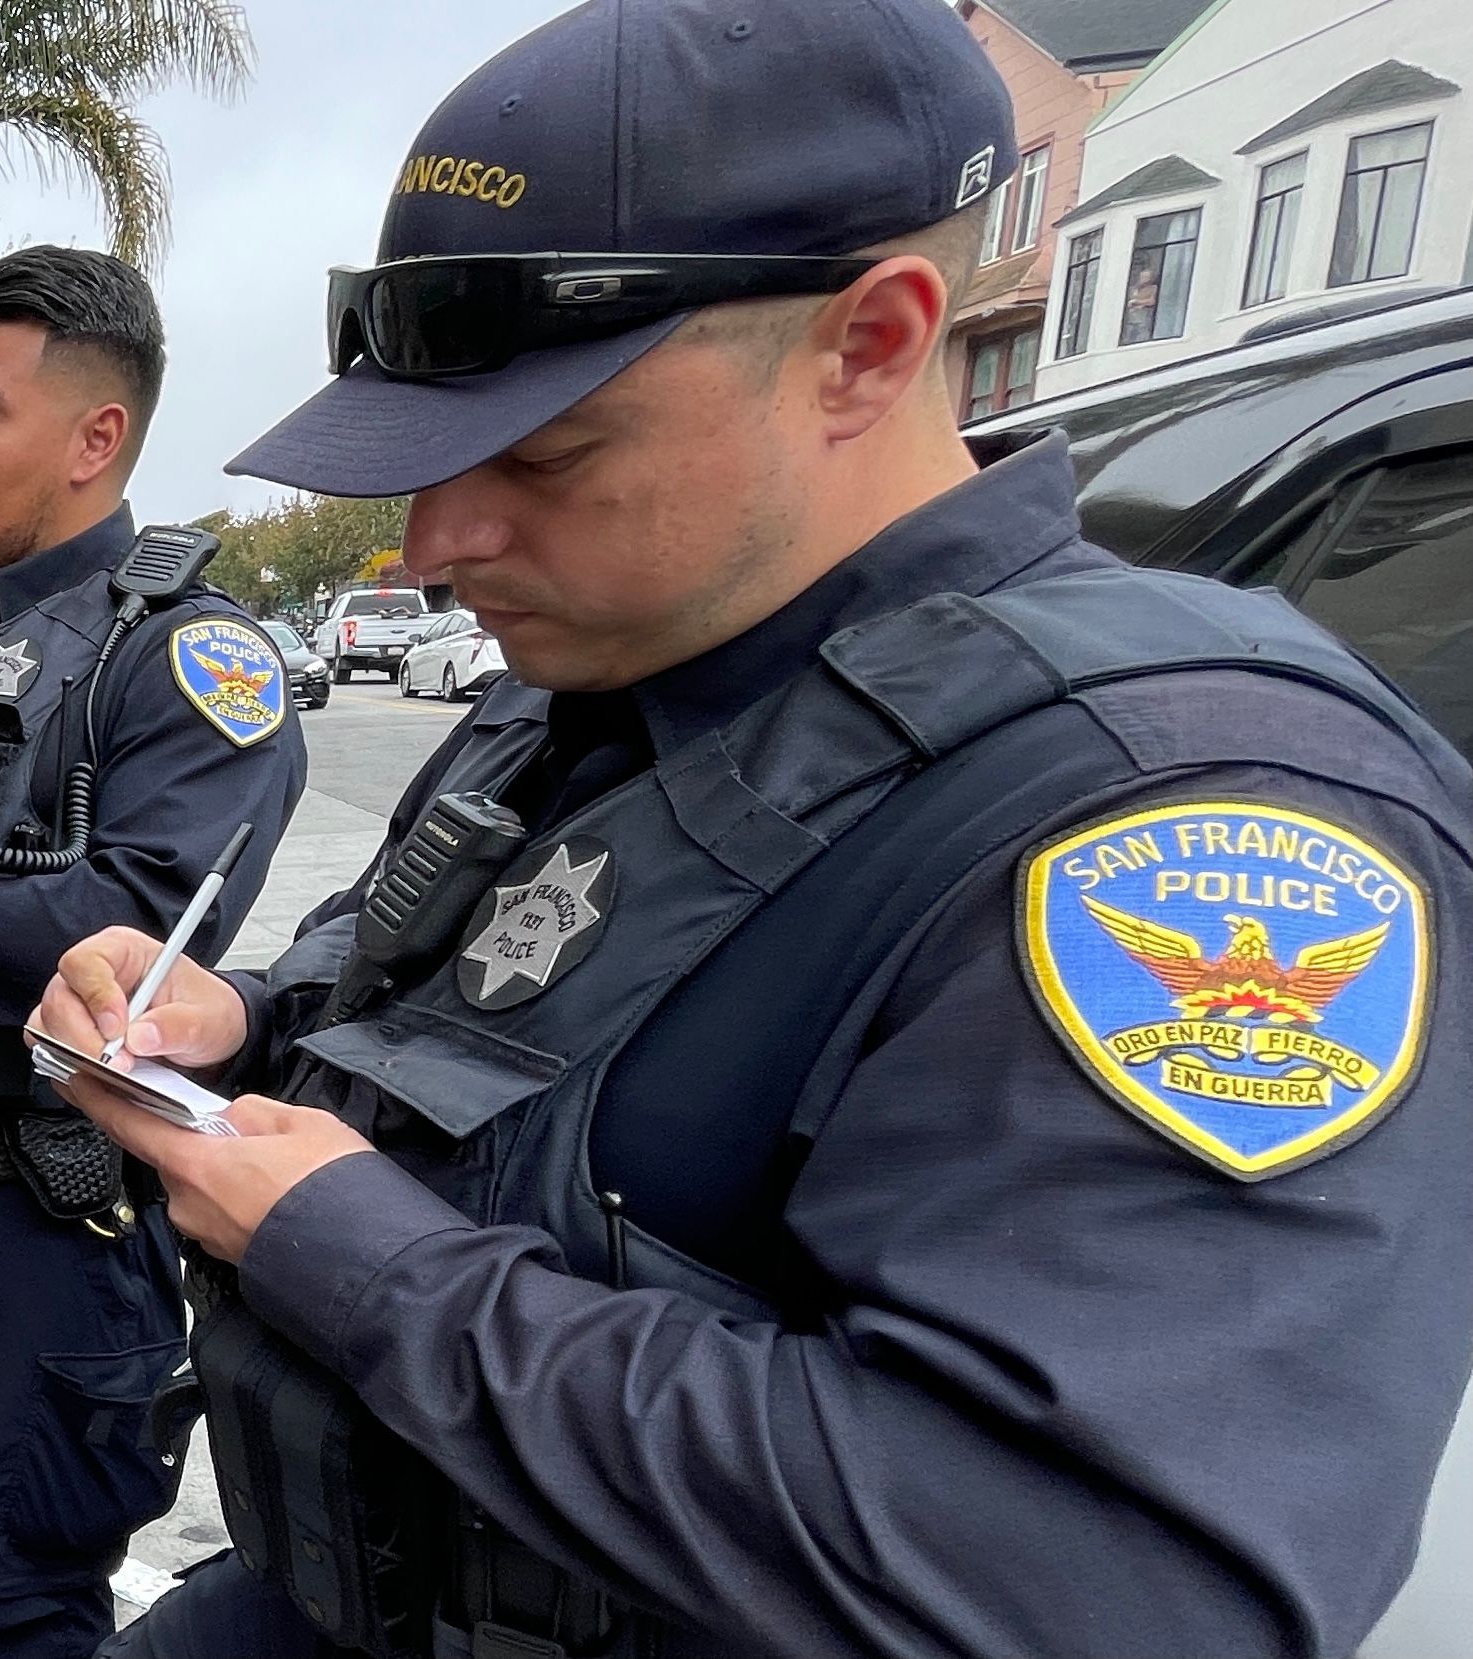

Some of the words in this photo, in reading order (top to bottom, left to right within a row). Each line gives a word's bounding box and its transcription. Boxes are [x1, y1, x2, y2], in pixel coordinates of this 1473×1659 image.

[181, 627, 213, 646] SAN
[214, 626, 277, 669] FRANCISCO
[209, 641, 262, 666] POLICE
[1063, 831, 1164, 891] SAN
[1174, 821, 1401, 915] FRANCISCO
[502, 889, 531, 916] SAN
[531, 883, 577, 933] FRANCISCO
[1156, 870, 1338, 916] POLICE
[493, 931, 539, 960] POLICE
[1113, 1029, 1161, 1055] ORO
[1165, 1025, 1195, 1043] EN
[1199, 1026, 1243, 1049] PAZ
[1267, 1032, 1363, 1075] FIERRO
[1169, 1067, 1204, 1092] EN
[1211, 1073, 1325, 1103] GUERRA
